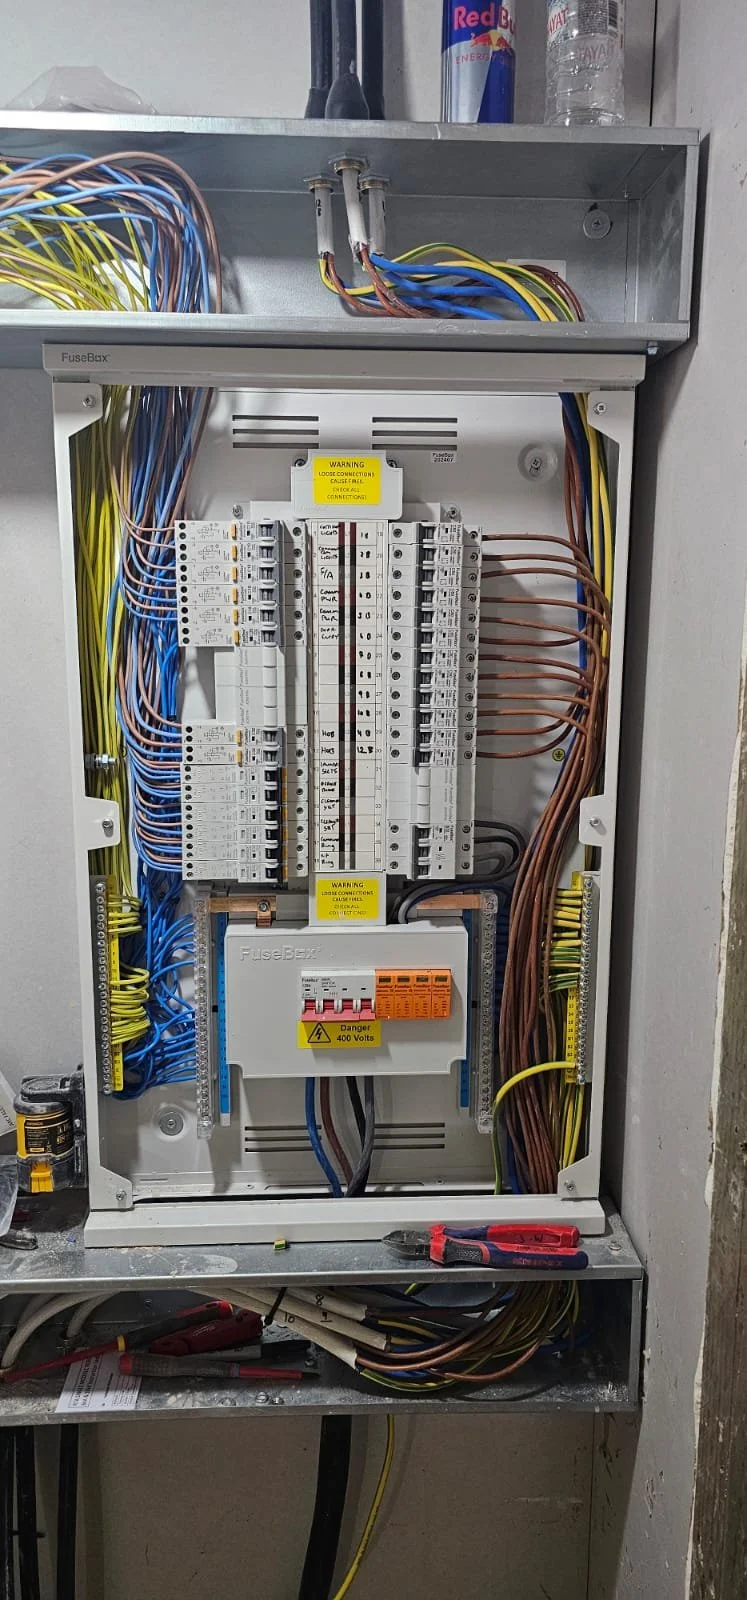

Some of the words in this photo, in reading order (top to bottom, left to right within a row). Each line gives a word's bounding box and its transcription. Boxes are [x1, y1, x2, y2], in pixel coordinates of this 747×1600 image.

[454, 2, 496, 31] Red
[61, 352, 108, 363] FuseBox
[239, 945, 318, 962] FuseBox
